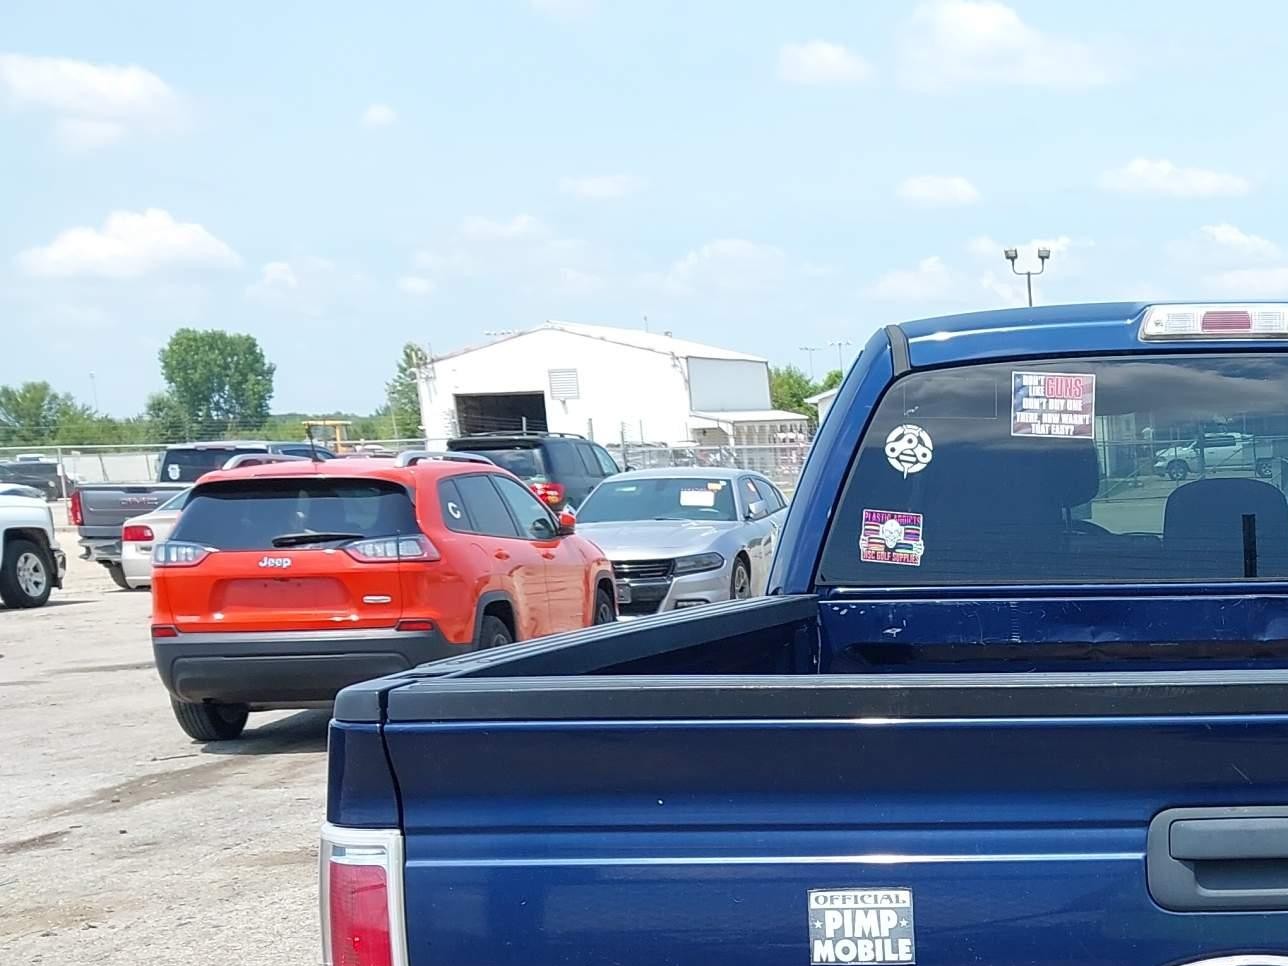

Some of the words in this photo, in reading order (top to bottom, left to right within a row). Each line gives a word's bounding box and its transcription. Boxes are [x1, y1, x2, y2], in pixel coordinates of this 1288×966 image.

[1045, 377, 1082, 398] GUNS
[865, 512, 891, 523] PLASTIC
[894, 515, 921, 526] ADDICTS
[258, 556, 292, 568] Jeep
[876, 551, 891, 561] GOLF
[892, 553, 919, 563] SUPPLIES
[814, 894, 907, 905] OFFICIAL
[824, 909, 898, 938] PIMP
[813, 938, 913, 962] MOBILE
